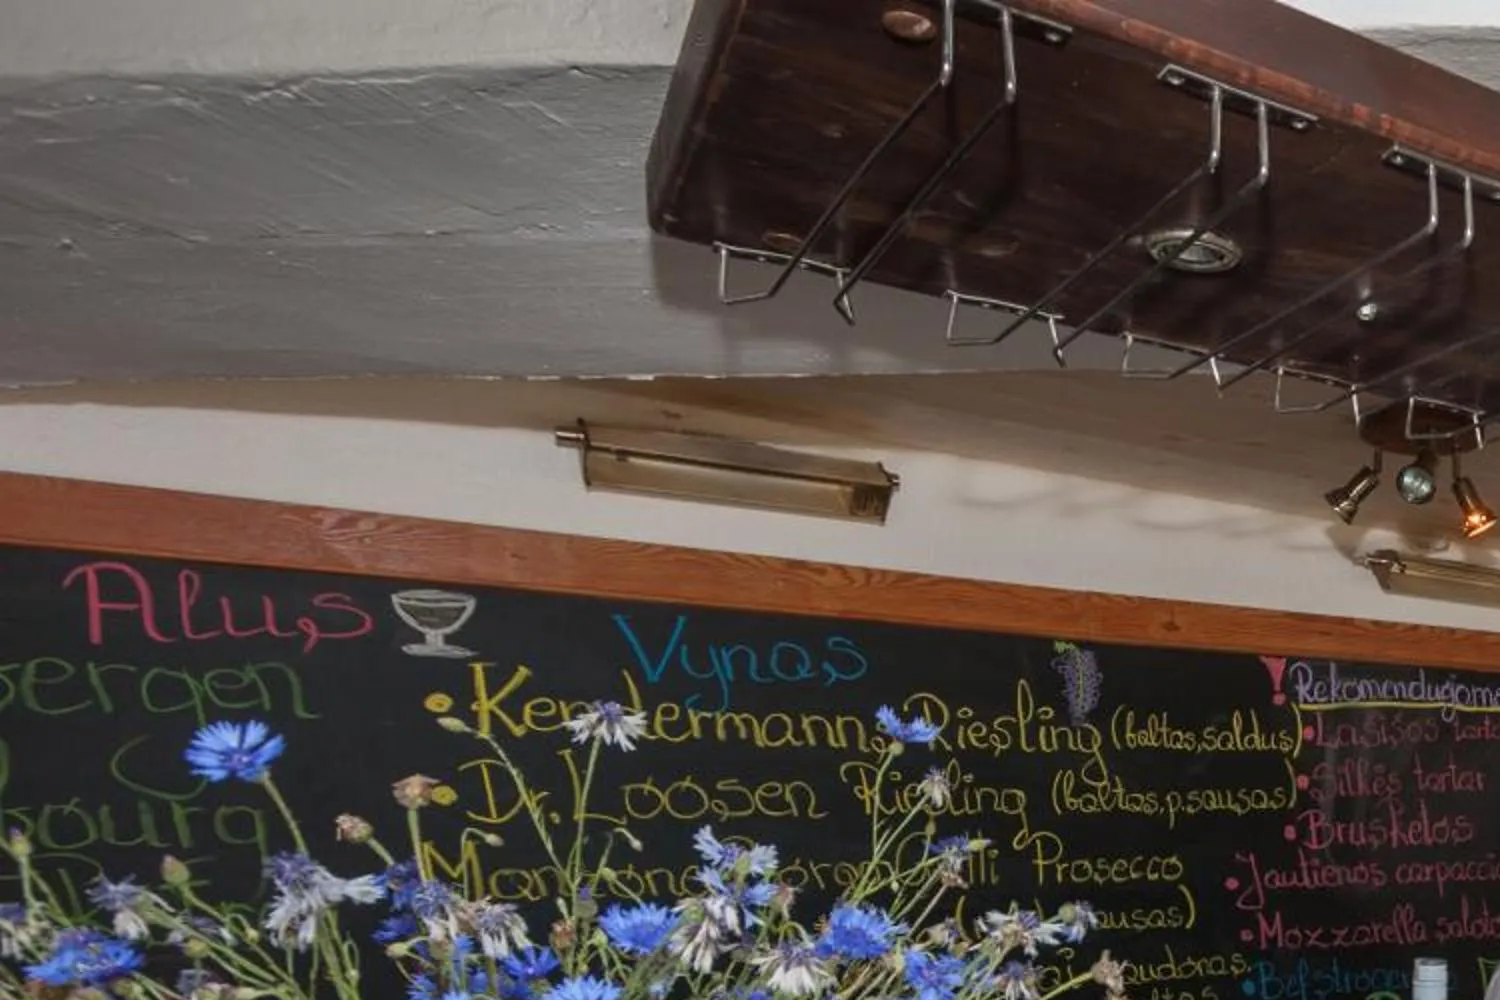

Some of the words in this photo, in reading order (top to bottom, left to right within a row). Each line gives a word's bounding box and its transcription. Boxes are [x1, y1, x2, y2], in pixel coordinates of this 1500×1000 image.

[62, 560, 374, 652] Alus
[612, 614, 868, 711] Vynas
[1028, 832, 1184, 886] Prosecco
